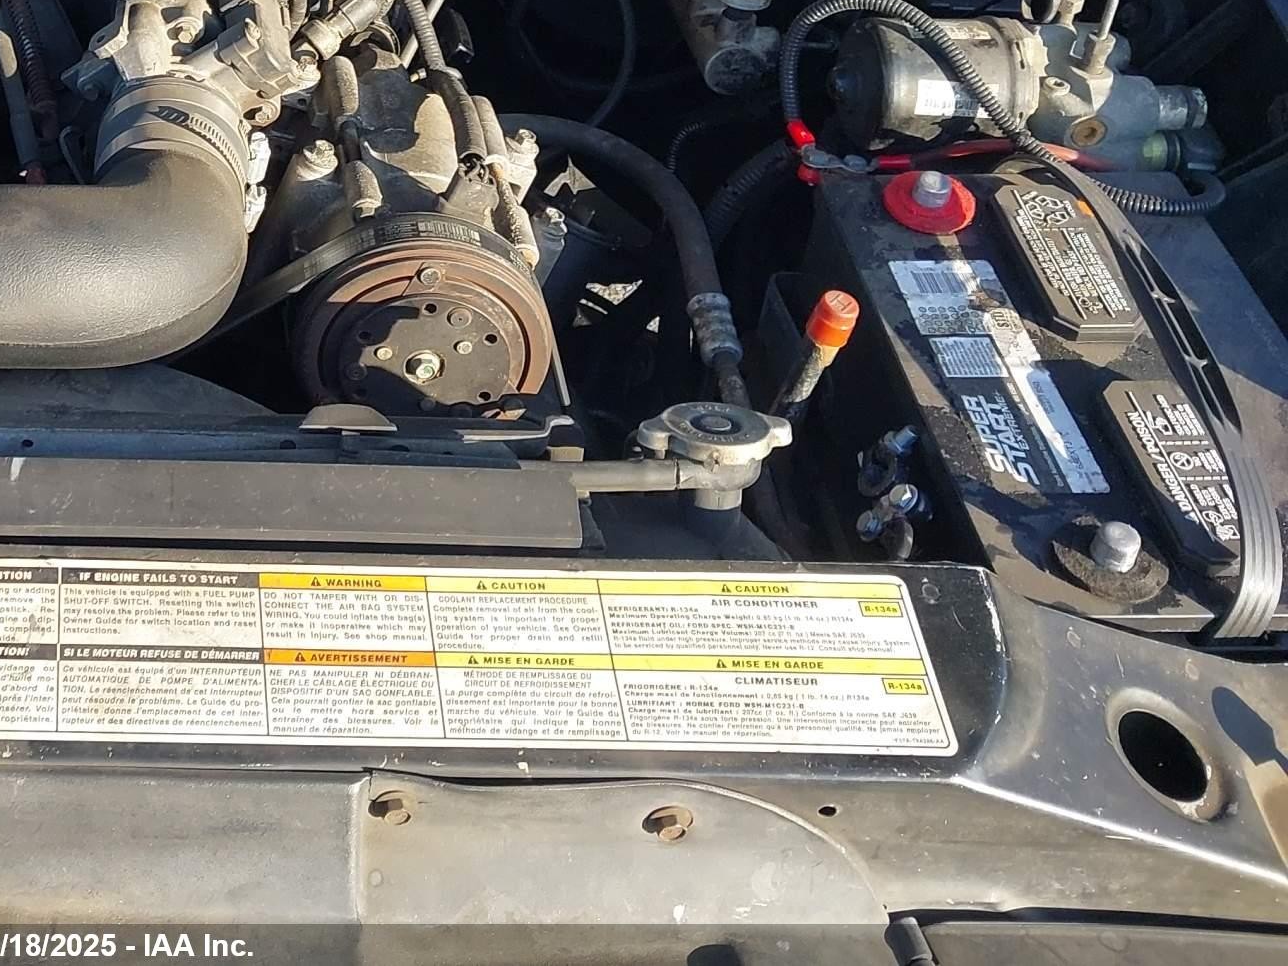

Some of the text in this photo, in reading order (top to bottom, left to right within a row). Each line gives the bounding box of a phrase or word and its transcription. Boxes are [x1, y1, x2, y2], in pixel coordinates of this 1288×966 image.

[961, 395, 1011, 474] SUPER
[1127, 412, 1161, 454] POISON
[982, 394, 1040, 486] START
[1157, 463, 1194, 512] DANGER
[79, 572, 238, 584] IF ENGINE FAILS TO START
[325, 578, 382, 587] WARNING
[24, 586, 55, 595] adding
[129, 588, 170, 597] equipped
[228, 590, 255, 598] PUMP
[263, 591, 277, 599] DO
[404, 594, 422, 602] DIS-
[63, 596, 109, 604] SHUT-OFF
[112, 597, 152, 605] SWITCH.
[158, 598, 202, 608] Resetting
[226, 600, 255, 608] switch
[263, 601, 308, 609] CONNECT
[734, 599, 818, 608] CONDITIONER
[63, 608, 81, 616] may
[134, 608, 173, 616] problem.
[176, 608, 205, 616] Please
[264, 610, 302, 618] WIRING.
[397, 614, 425, 622] bag(s)
[37, 616, 55, 624] dip-
[95, 616, 122, 624] Guide
[173, 618, 210, 626] location
[62, 626, 120, 634] instructions.
[310, 631, 338, 640] injury.
[63, 648, 259, 660] SI LE MOTEUR REFUSE DE DÉMARRER
[309, 653, 408, 662] AVERTISSEMENT
[483, 656, 511, 664] MISE
[535, 657, 574, 665] GARDE
[764, 660, 779, 668] EN
[734, 677, 817, 685] CLIMATISEUR
[885, 682, 925, 690] R-134a
